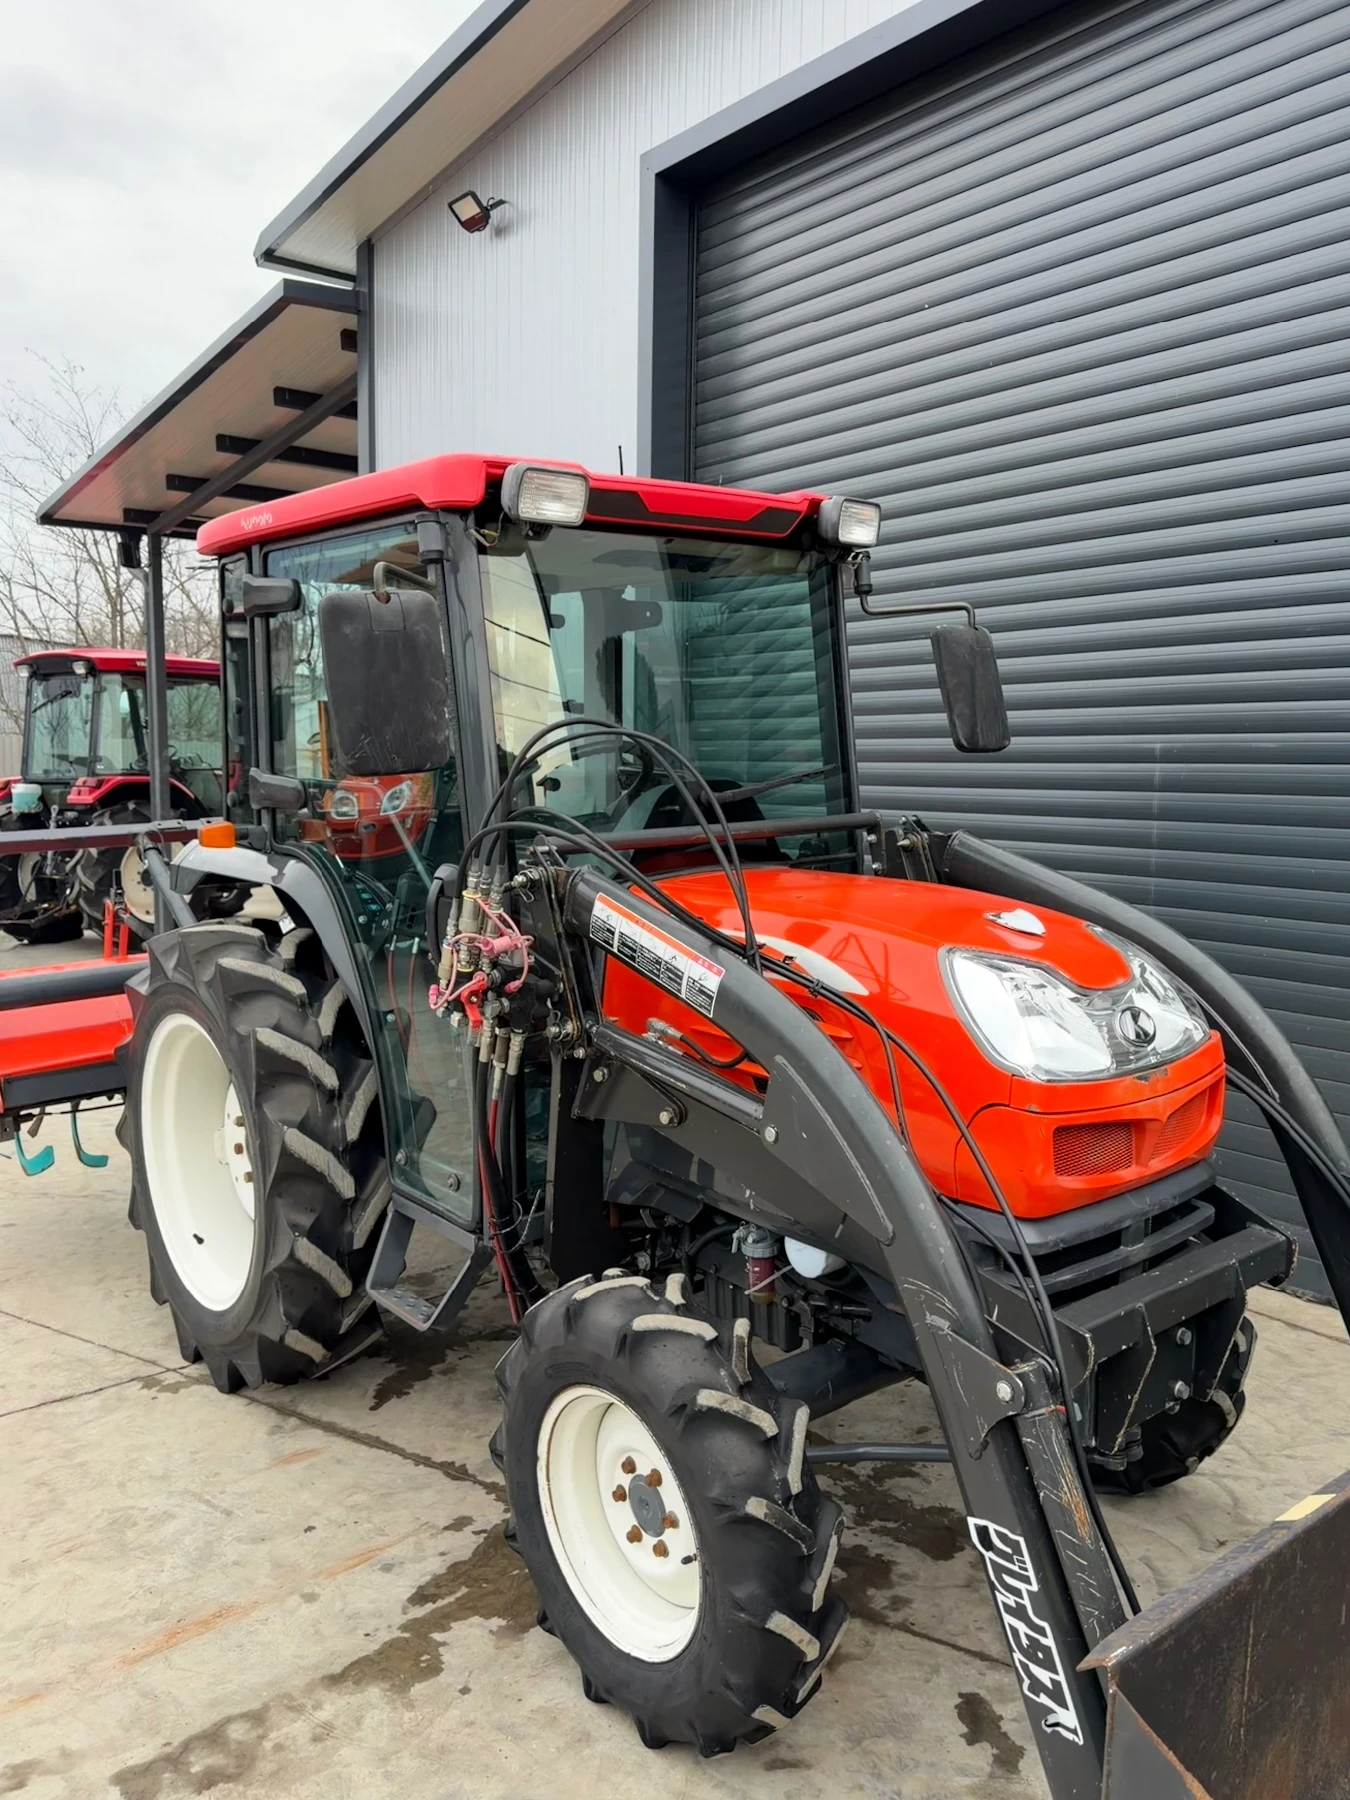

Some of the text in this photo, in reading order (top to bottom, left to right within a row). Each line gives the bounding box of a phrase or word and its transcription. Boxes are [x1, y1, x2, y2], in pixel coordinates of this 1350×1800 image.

[968, 1517, 1074, 1715] グレイタス
